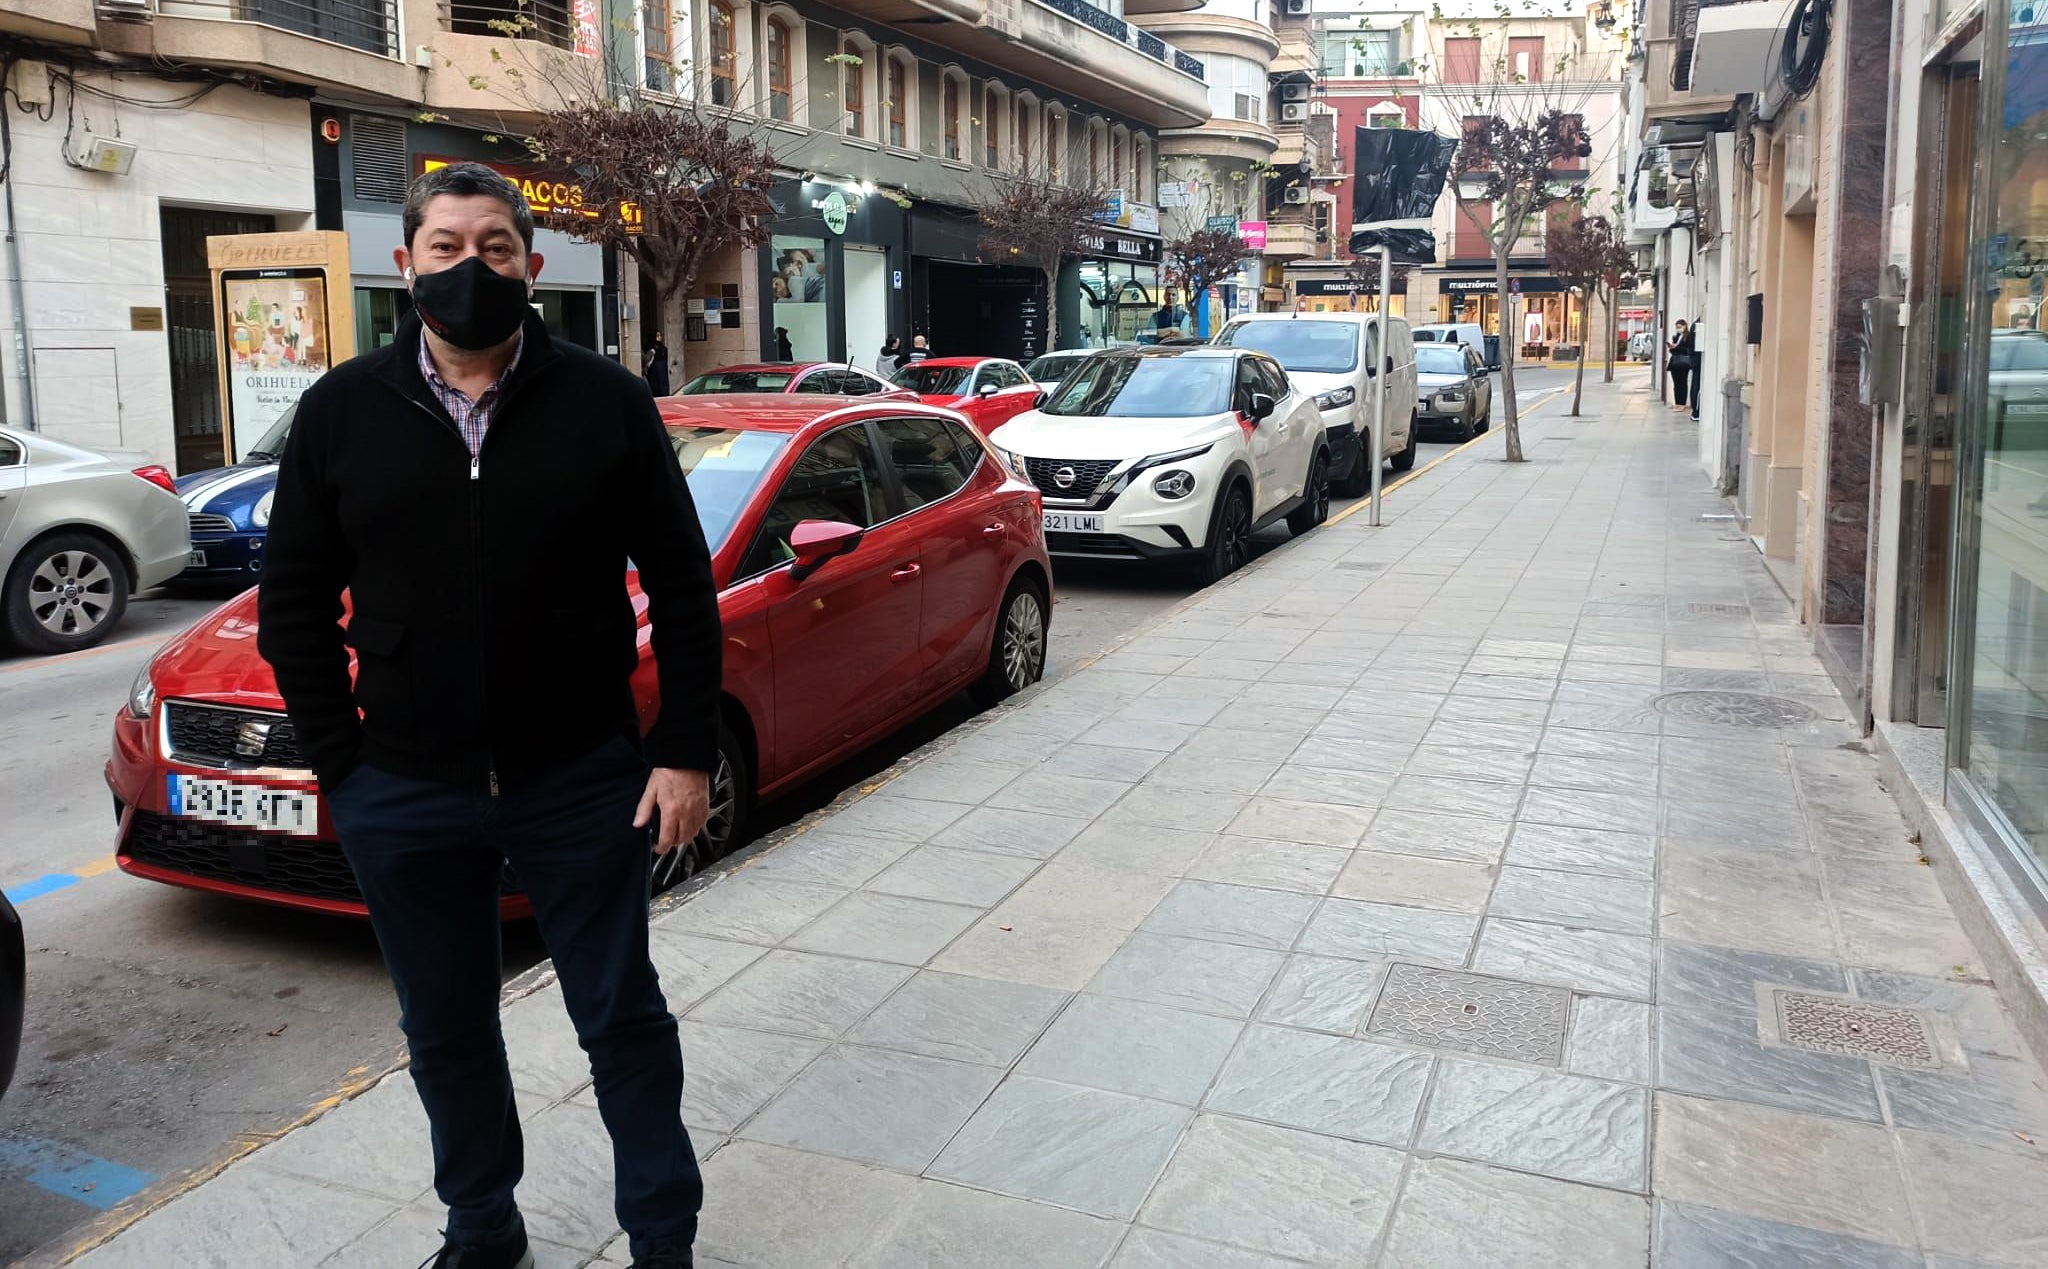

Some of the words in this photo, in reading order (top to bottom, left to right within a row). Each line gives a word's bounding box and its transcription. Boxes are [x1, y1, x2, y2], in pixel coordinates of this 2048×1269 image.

[1117, 239, 1141, 255] BELLA
[246, 376, 313, 389] ORIHUELA
[1074, 517, 1101, 531] LML
